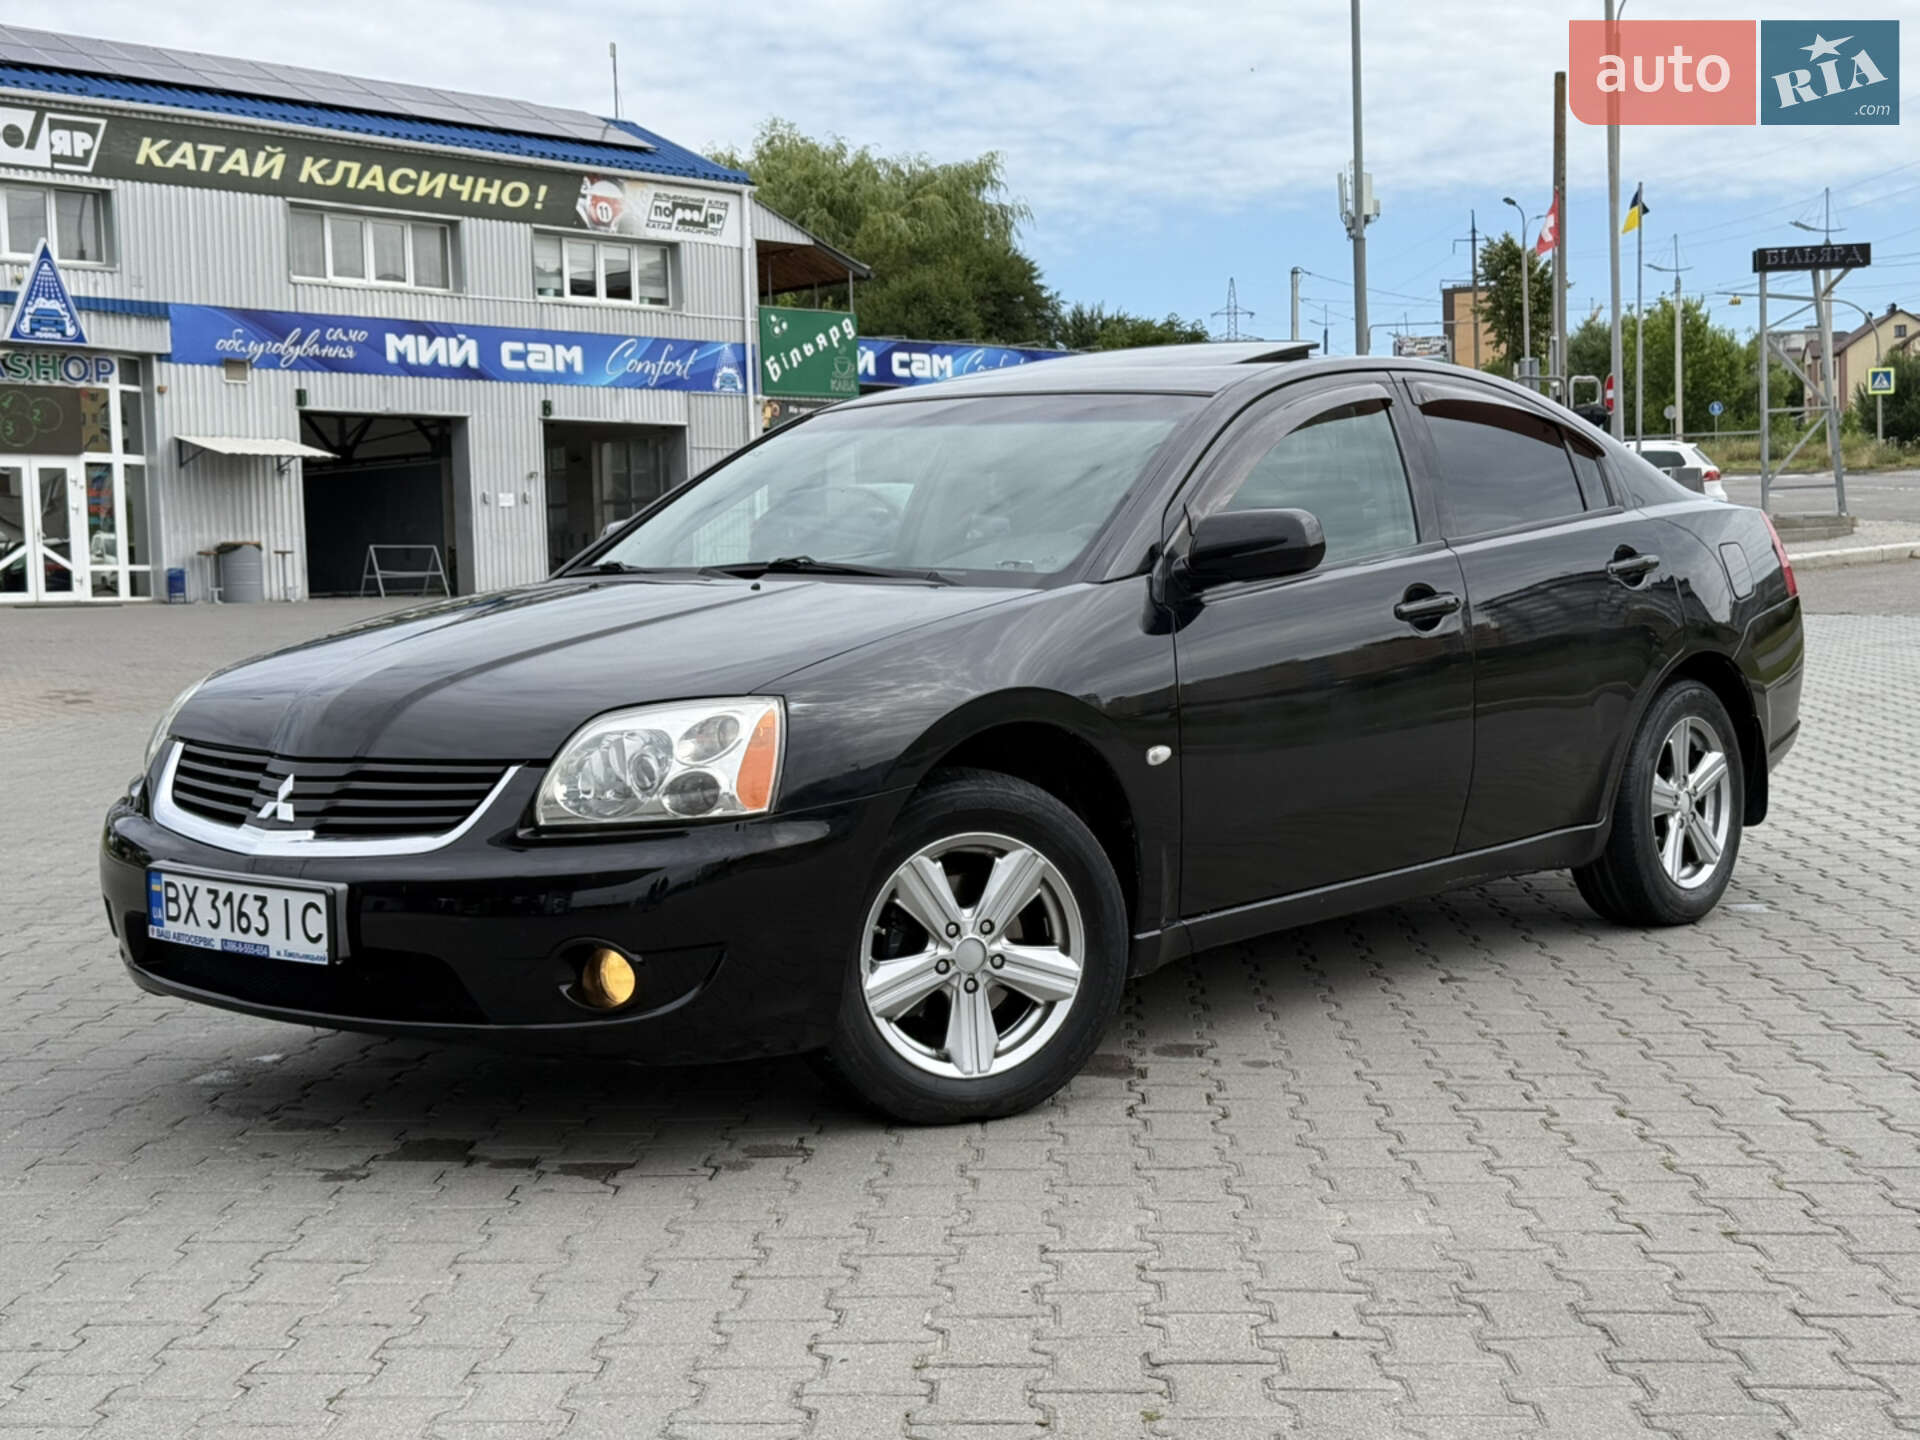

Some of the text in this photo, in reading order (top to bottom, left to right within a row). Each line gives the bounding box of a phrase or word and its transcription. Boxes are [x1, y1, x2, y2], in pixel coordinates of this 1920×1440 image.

[51, 129, 94, 158] ЯР
[135, 137, 549, 210] КАТАЙ КЛАСИЧНО!
[1765, 245, 1863, 265] БІЛЬЯРД
[215, 328, 357, 368] обслуговування
[325, 327, 368, 342] само
[605, 338, 698, 386] Comfort
